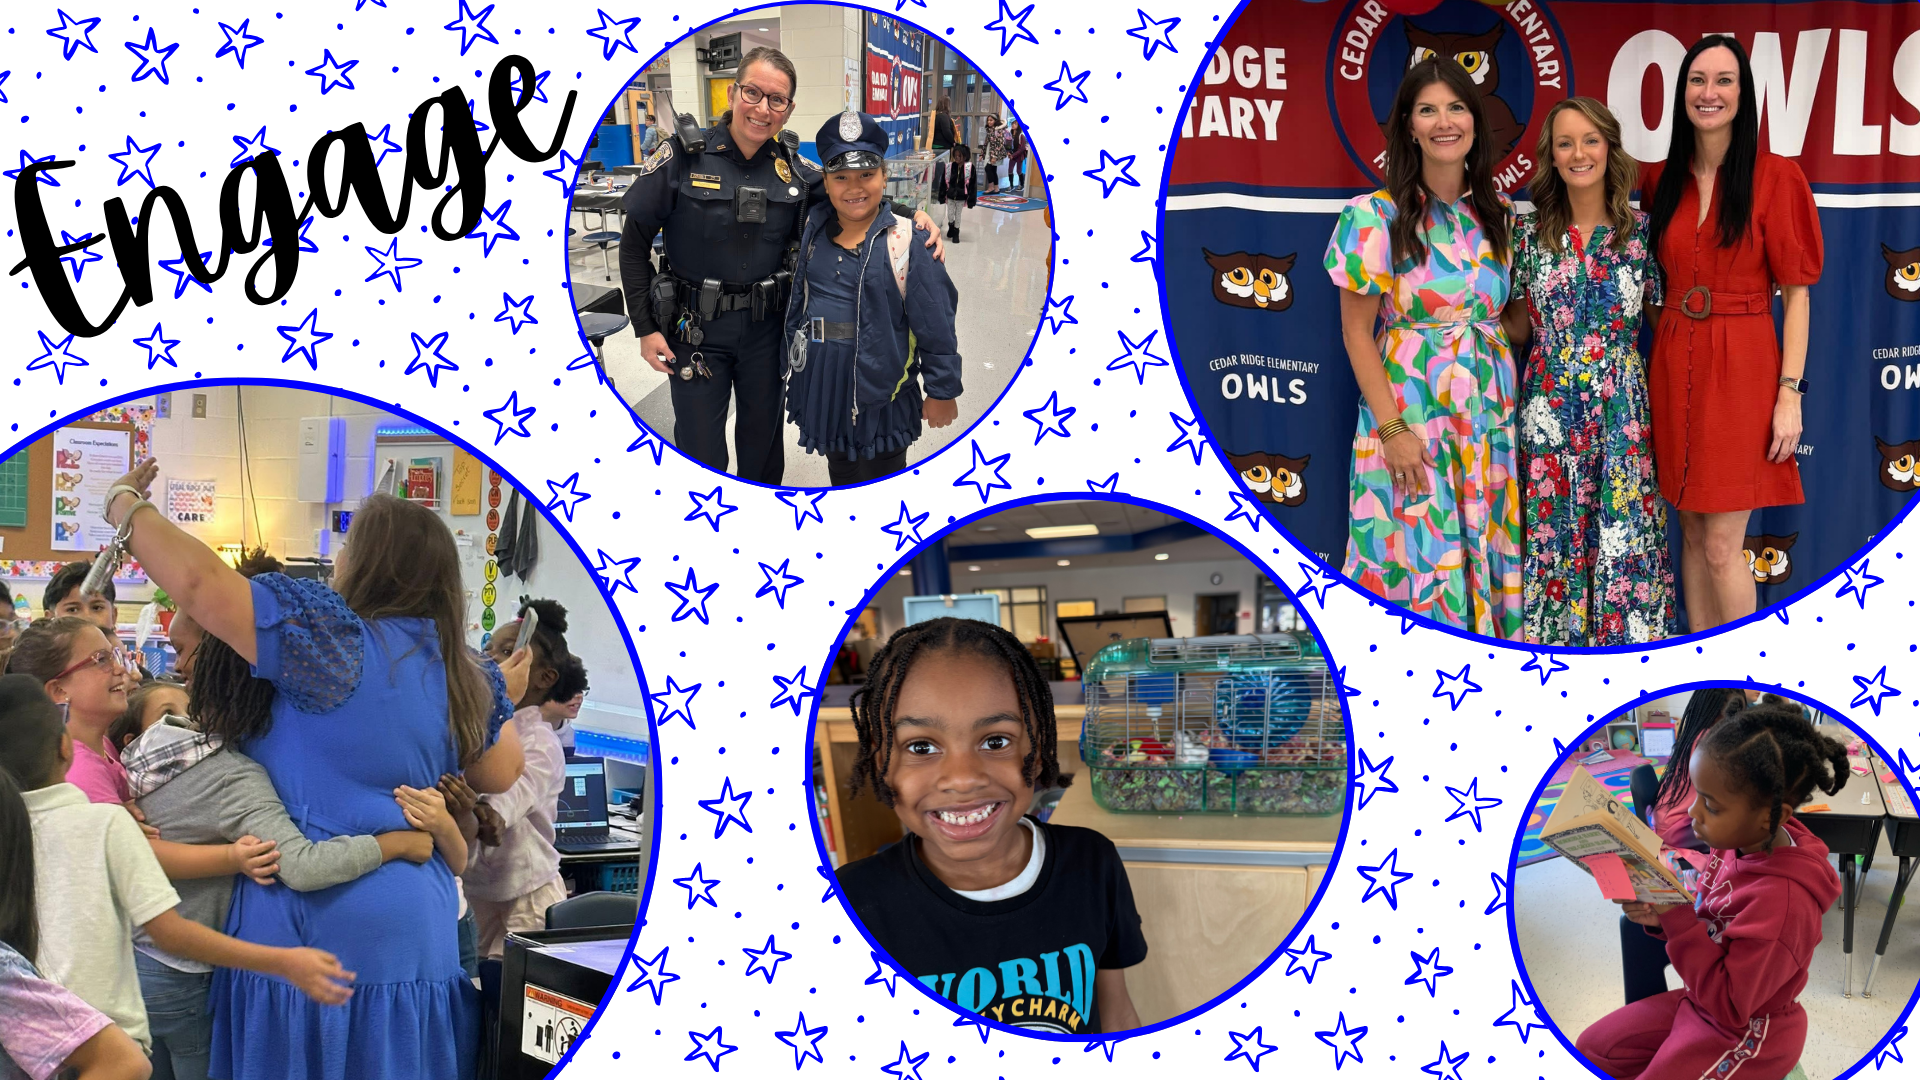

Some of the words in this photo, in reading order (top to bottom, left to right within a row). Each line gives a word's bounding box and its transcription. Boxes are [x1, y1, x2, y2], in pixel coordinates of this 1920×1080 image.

[1340, 0, 1388, 80] CEDAR
[1202, 44, 1287, 90] DGE
[1491, 153, 1532, 193] OWLS
[1209, 355, 1239, 371] CEDAR
[1240, 353, 1266, 367] RIDGE
[1267, 356, 1319, 374] ELEMENTARY
[1873, 347, 1900, 360] CEDAR
[1902, 345, 1920, 357] RIDG
[1221, 373, 1307, 405] OWLS
[177, 512, 205, 522] CARE
[534, 990, 563, 1008] WARNING
